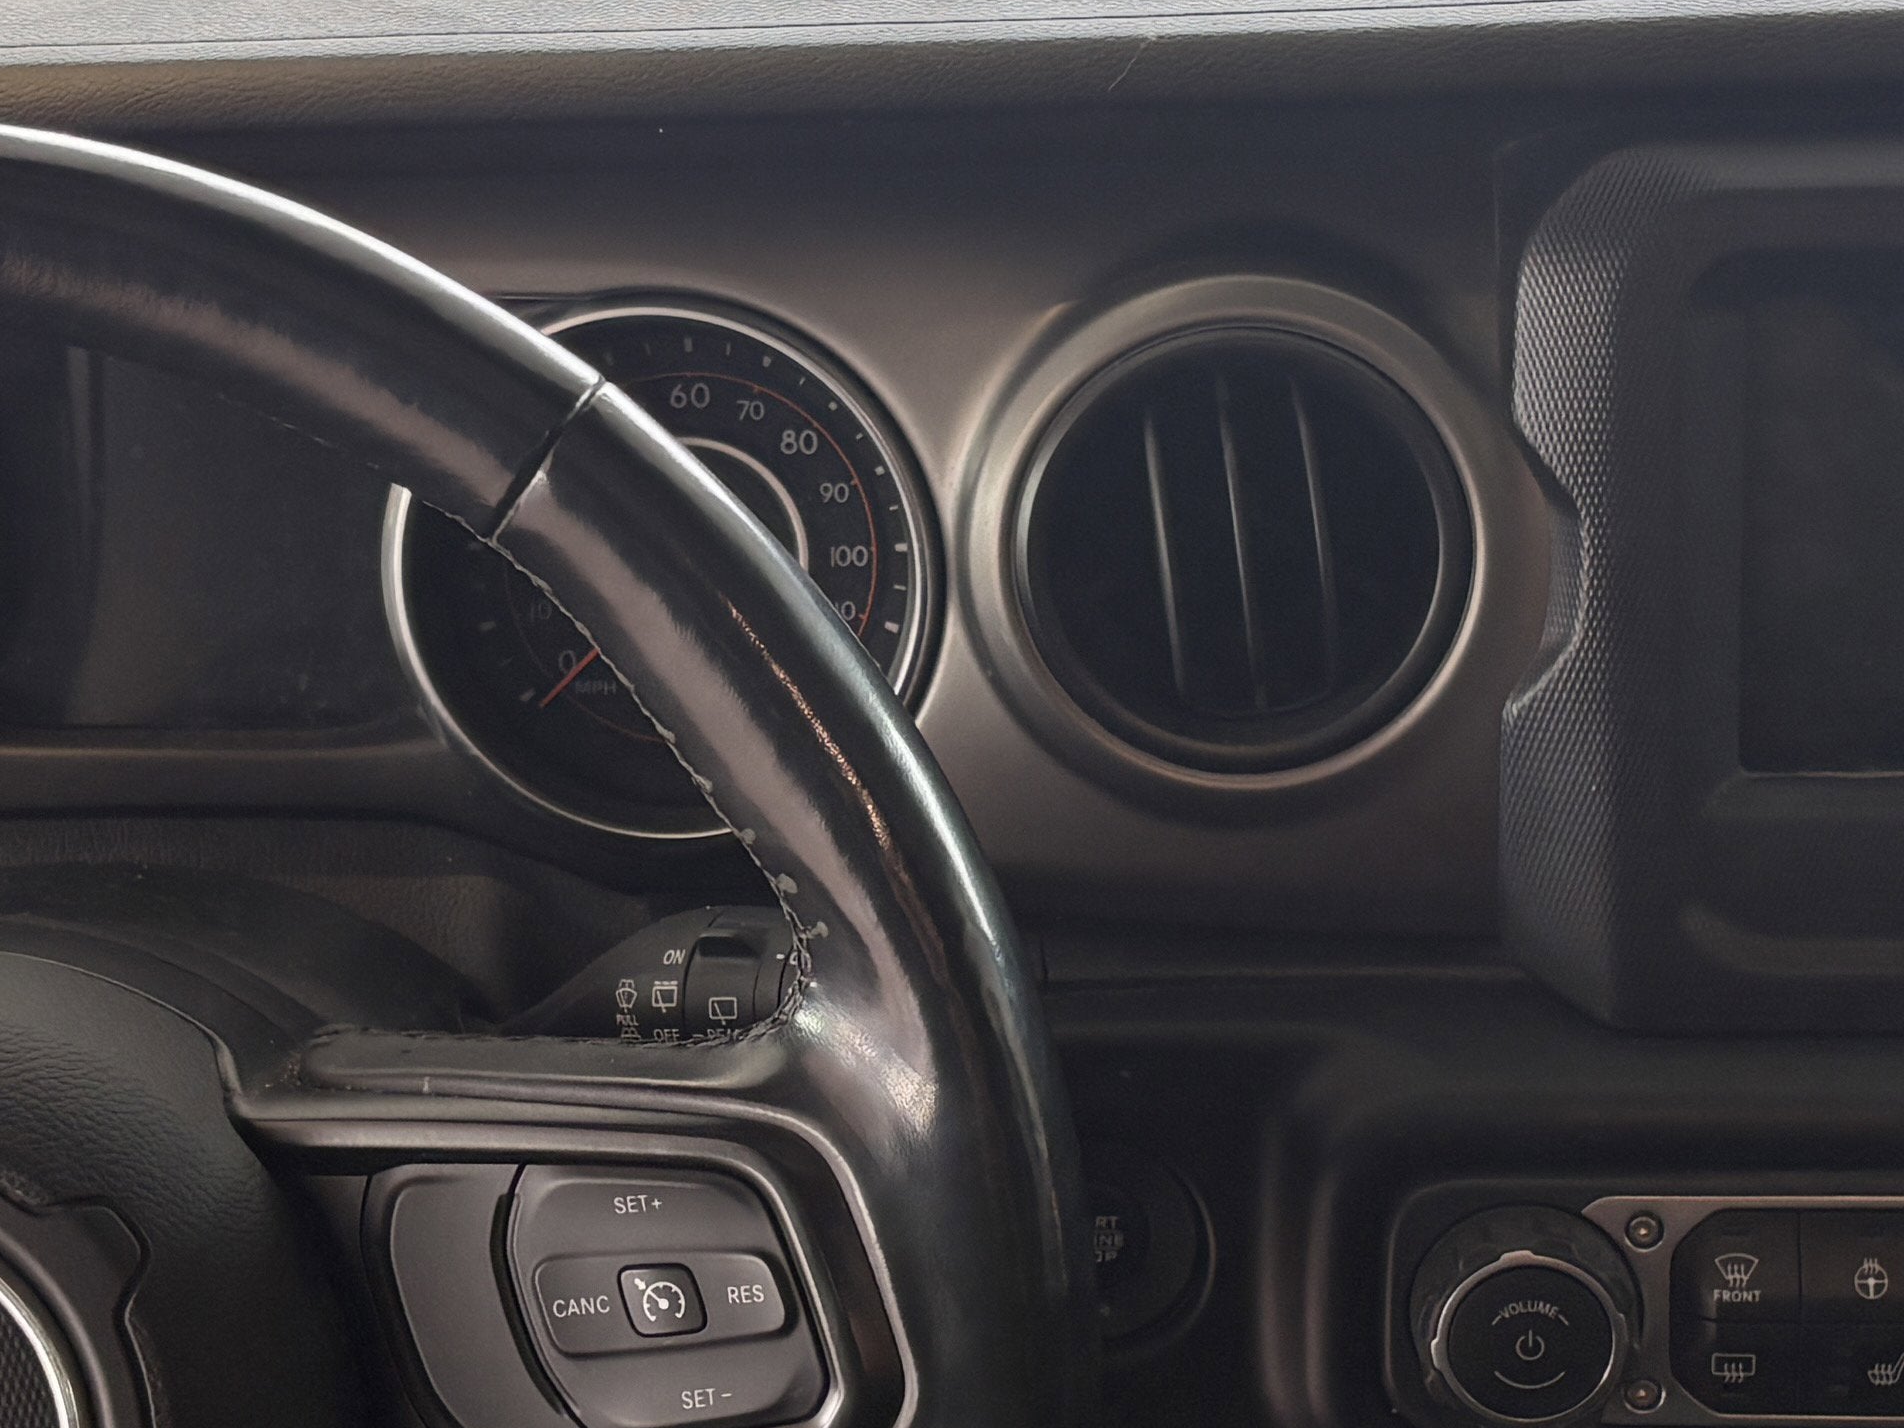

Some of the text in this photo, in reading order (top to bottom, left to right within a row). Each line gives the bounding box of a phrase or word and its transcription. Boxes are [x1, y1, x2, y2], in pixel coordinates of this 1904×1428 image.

[669, 382, 711, 409] 60
[736, 400, 766, 421] 70
[779, 429, 818, 455] 80
[819, 482, 849, 504] 90
[830, 545, 869, 569] 100
[663, 949, 686, 965] ON
[654, 1029, 680, 1042] OFF
[727, 1284, 765, 1305] RES
[1713, 1288, 1761, 1303] FRONT
[552, 1295, 611, 1318] CANC
[1499, 1301, 1561, 1321] VOLUME
